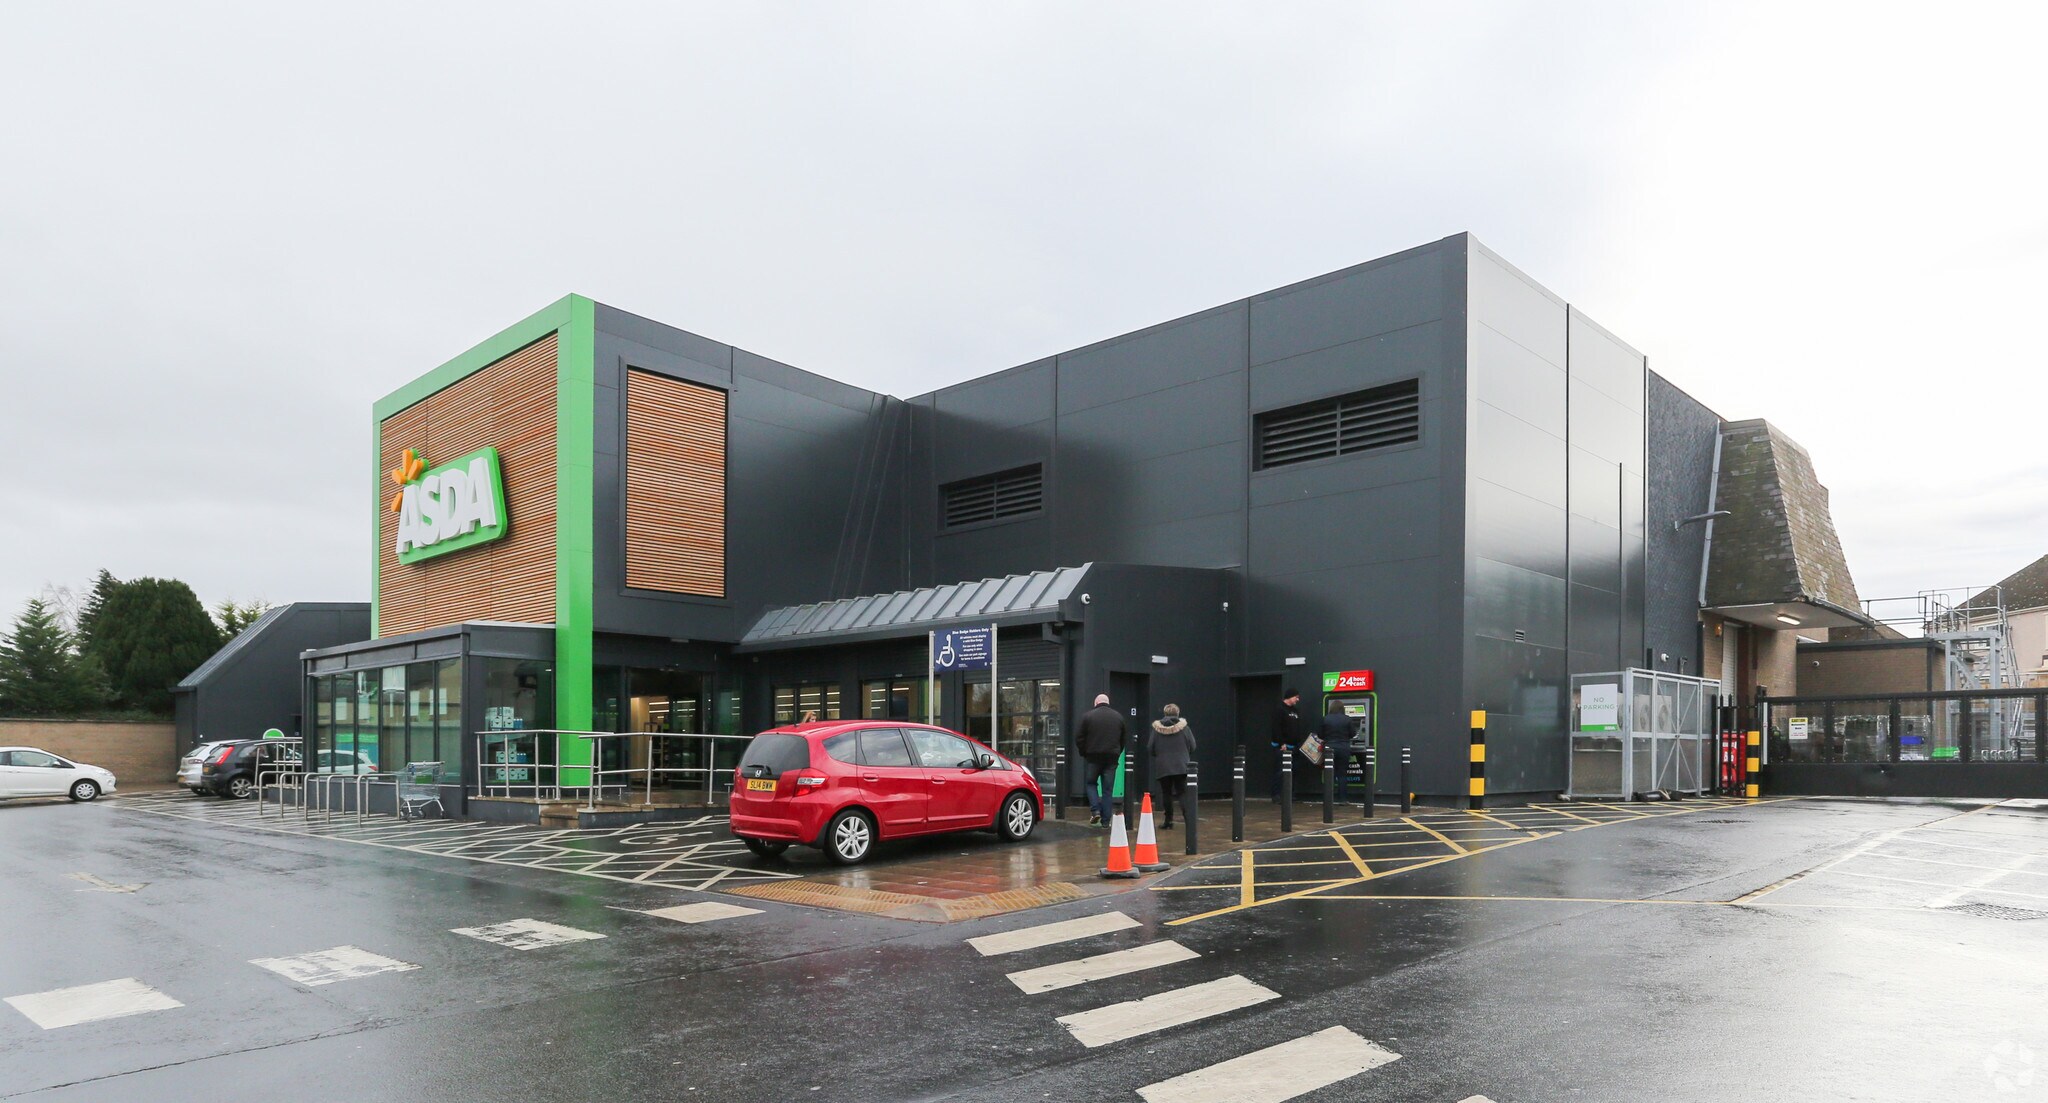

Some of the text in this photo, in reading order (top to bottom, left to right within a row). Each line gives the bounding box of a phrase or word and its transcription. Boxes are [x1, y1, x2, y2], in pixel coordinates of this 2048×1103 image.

[395, 456, 497, 554] ASDA
[1339, 676, 1353, 686] 24
[750, 781, 761, 789] SL14
